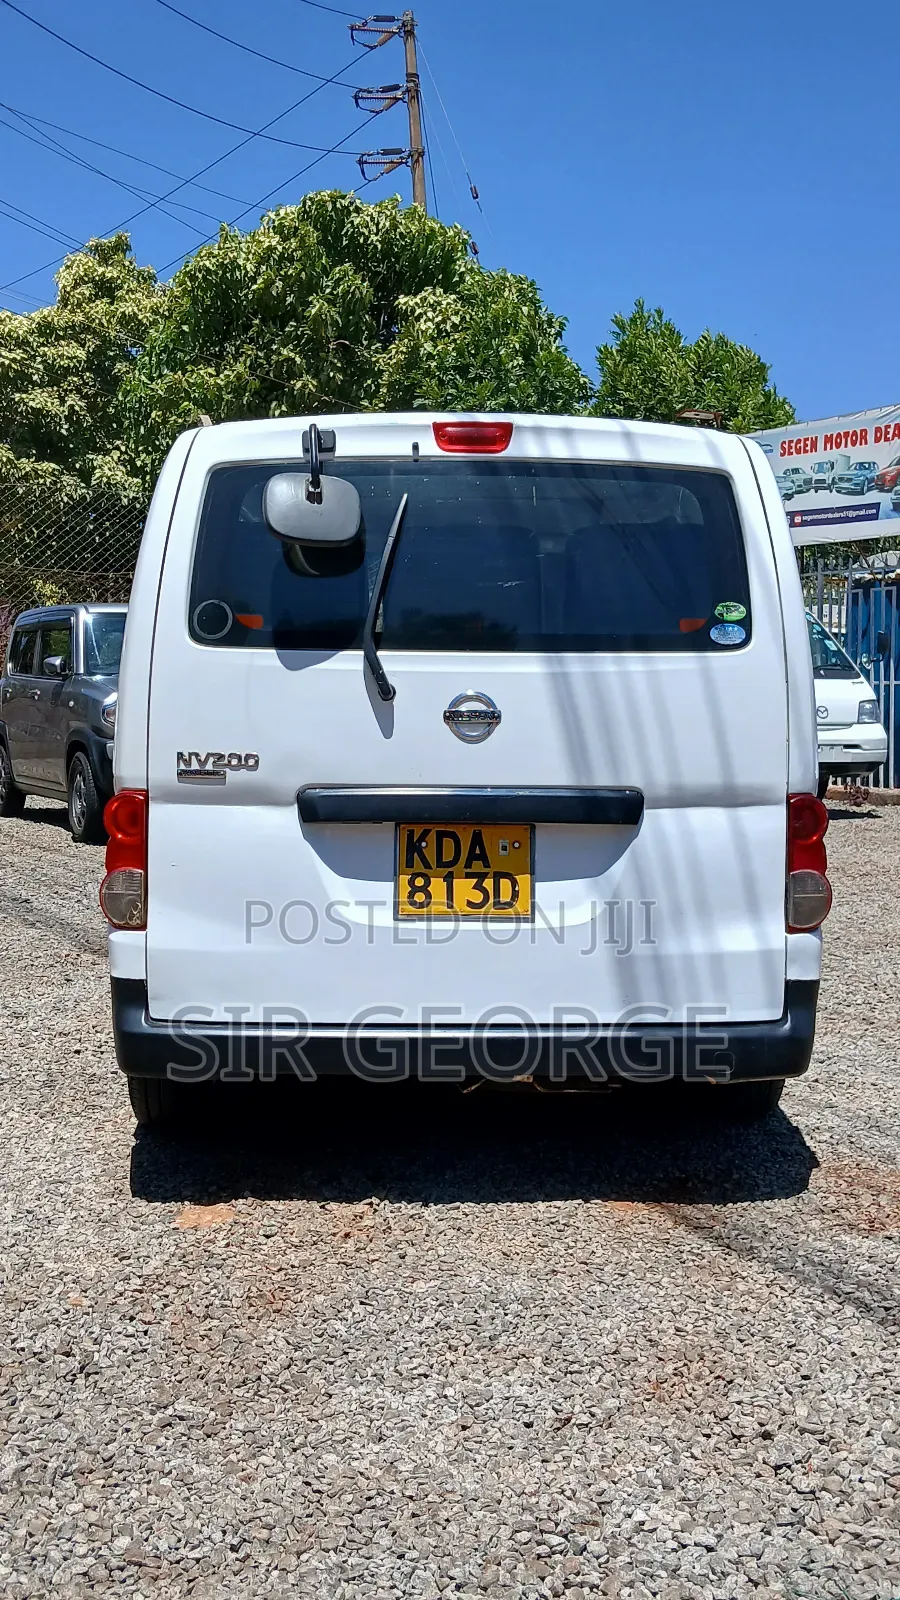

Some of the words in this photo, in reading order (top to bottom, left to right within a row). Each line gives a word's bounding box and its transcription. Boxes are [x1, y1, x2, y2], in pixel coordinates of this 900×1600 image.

[779, 436, 818, 457] SEGEN
[823, 429, 868, 451] MOTOR
[177, 751, 260, 771] NV200
[405, 829, 491, 869] KDA
[406, 871, 520, 910] 813D
